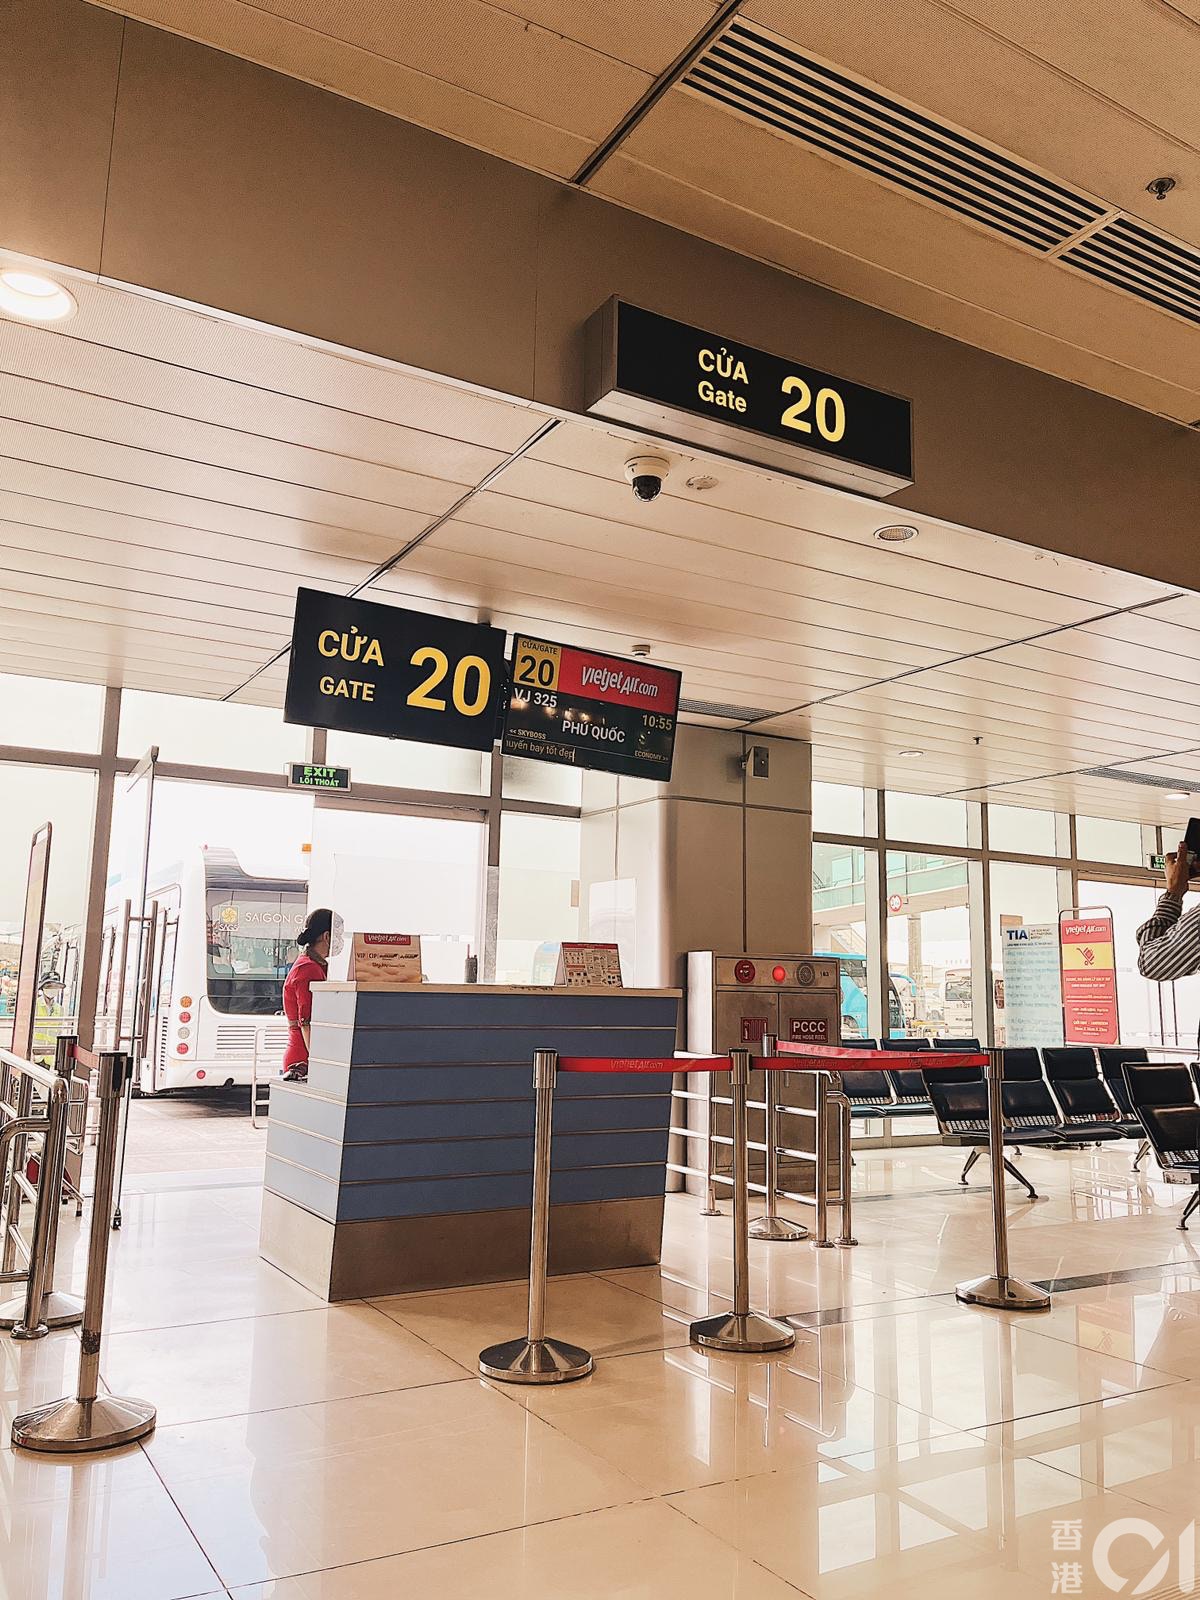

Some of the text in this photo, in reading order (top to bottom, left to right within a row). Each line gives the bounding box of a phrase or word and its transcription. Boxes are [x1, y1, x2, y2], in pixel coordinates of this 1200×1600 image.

[698, 347, 749, 385] CỬA
[698, 380, 747, 413] Gate
[781, 375, 846, 443] 20
[318, 625, 384, 667] CỬA
[519, 655, 555, 687] 20
[319, 676, 376, 702] GATE
[406, 646, 491, 717] 20
[514, 688, 558, 708] VJ 325
[562, 717, 626, 743] PHÚ QUỐC
[641, 714, 673, 731] 10:55
[517, 728, 547, 740] SKYBOSS
[530, 743, 545, 756] bay
[634, 750, 662, 761] ECONOMY
[303, 766, 336, 778] EXIT
[314, 777, 340, 787] THOÁT
[245, 912, 292, 924] SAIGON
[1006, 929, 1029, 941] TIA
[792, 1021, 826, 1033] PCCC
